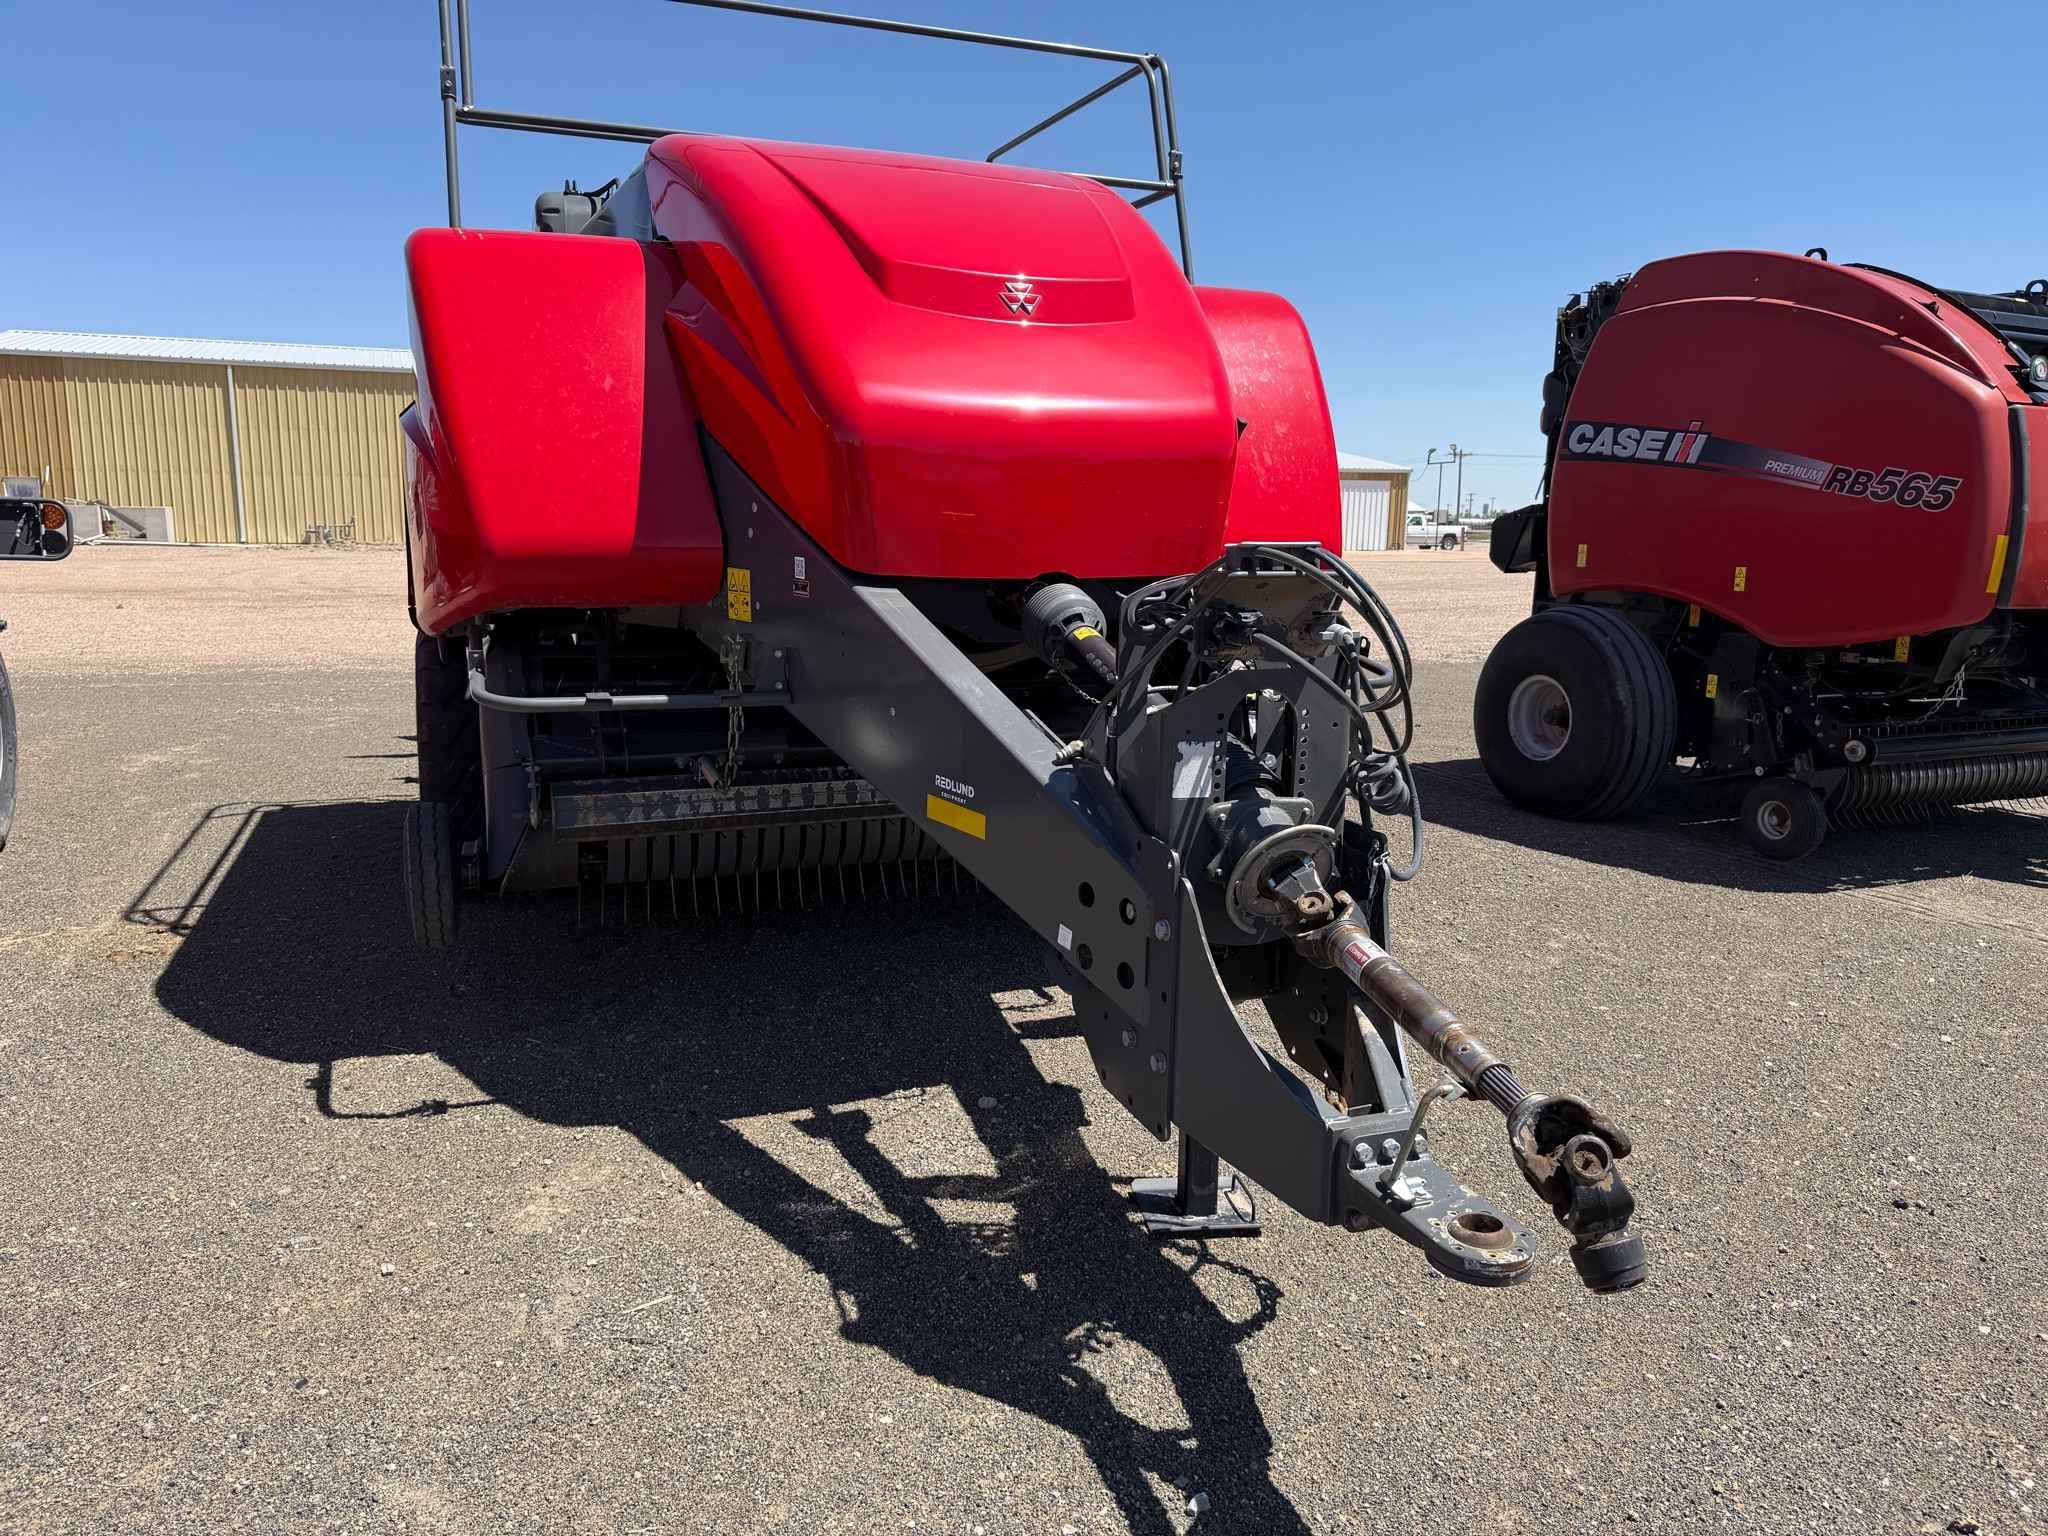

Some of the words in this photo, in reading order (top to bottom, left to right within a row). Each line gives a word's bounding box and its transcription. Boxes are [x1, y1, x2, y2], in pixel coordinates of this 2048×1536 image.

[1568, 424, 1668, 461] CASE
[1764, 460, 1825, 483] PREMIUM
[1823, 467, 1963, 512] RB565
[935, 775, 975, 798] REDLUND
[941, 791, 967, 805] EQUIPMENT
